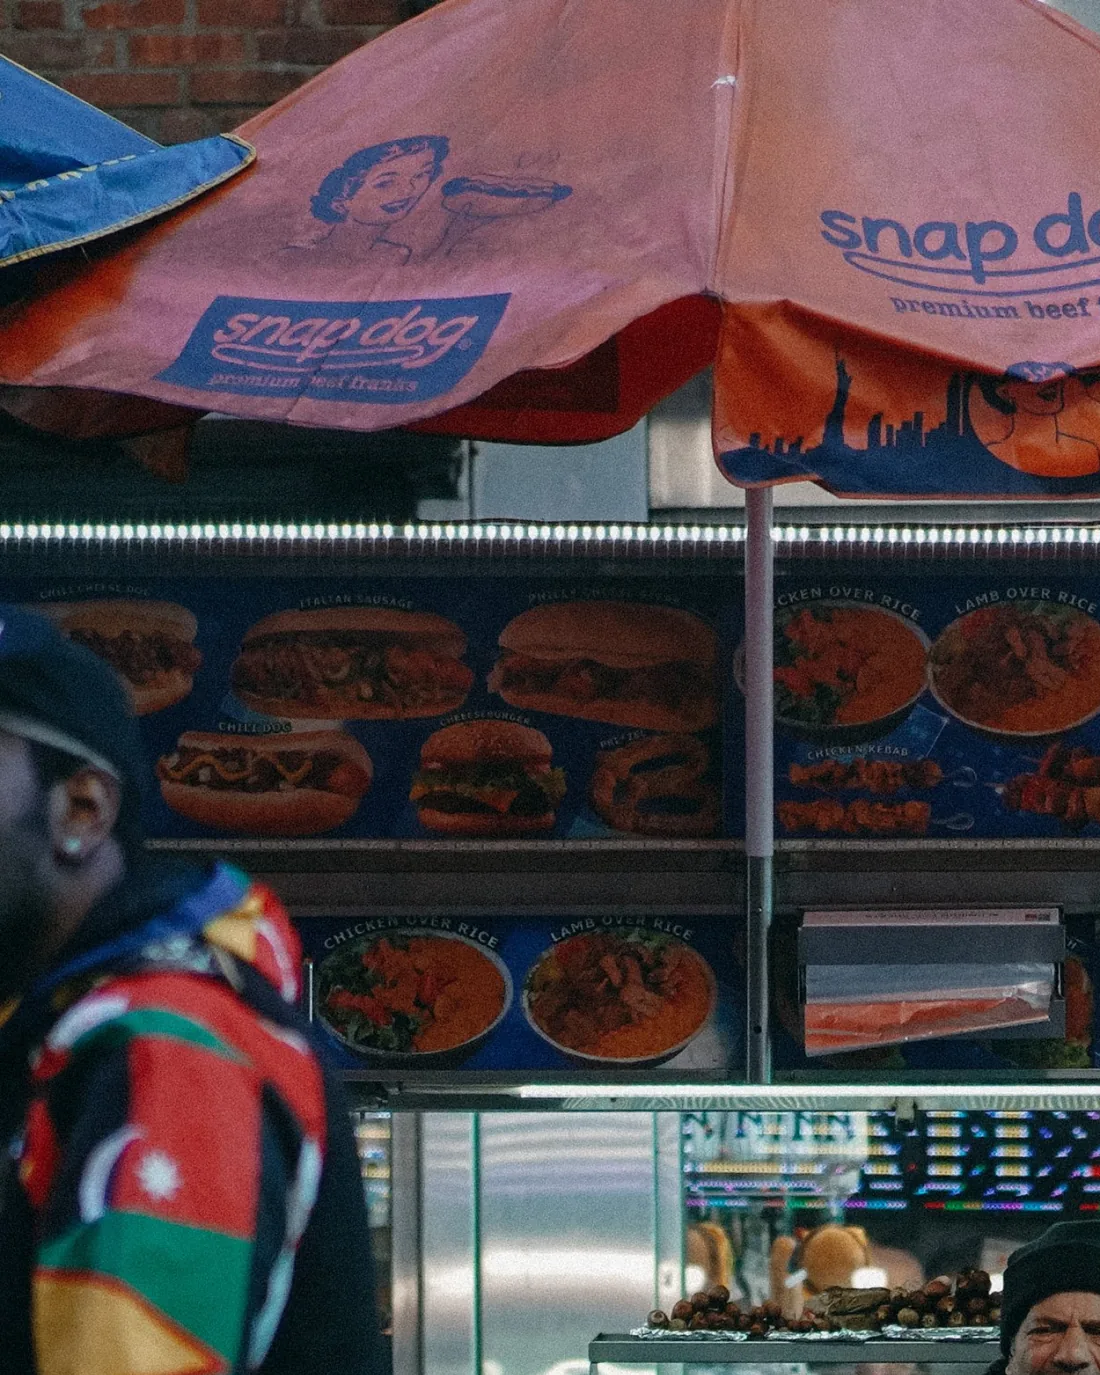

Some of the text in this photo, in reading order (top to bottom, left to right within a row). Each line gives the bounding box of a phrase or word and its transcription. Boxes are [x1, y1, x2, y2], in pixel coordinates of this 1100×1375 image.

[819, 209, 1019, 285] snap
[889, 295, 1021, 321] premium
[1025, 297, 1090, 320] beef
[212, 304, 480, 370] snap dog
[207, 373, 301, 389] premium
[348, 375, 419, 392] franks
[299, 594, 415, 610] ITALIAN SAUSAGE
[828, 585, 875, 602] OVER
[879, 594, 924, 621] RICE
[954, 585, 1098, 615] LAMB OVER RICE
[217, 721, 292, 734] CHILI DOG
[806, 744, 909, 761] CHICKEN KEBAB
[322, 915, 500, 951] CHICKEN OVER RICE
[549, 915, 695, 943] LAMB OVER RICE
